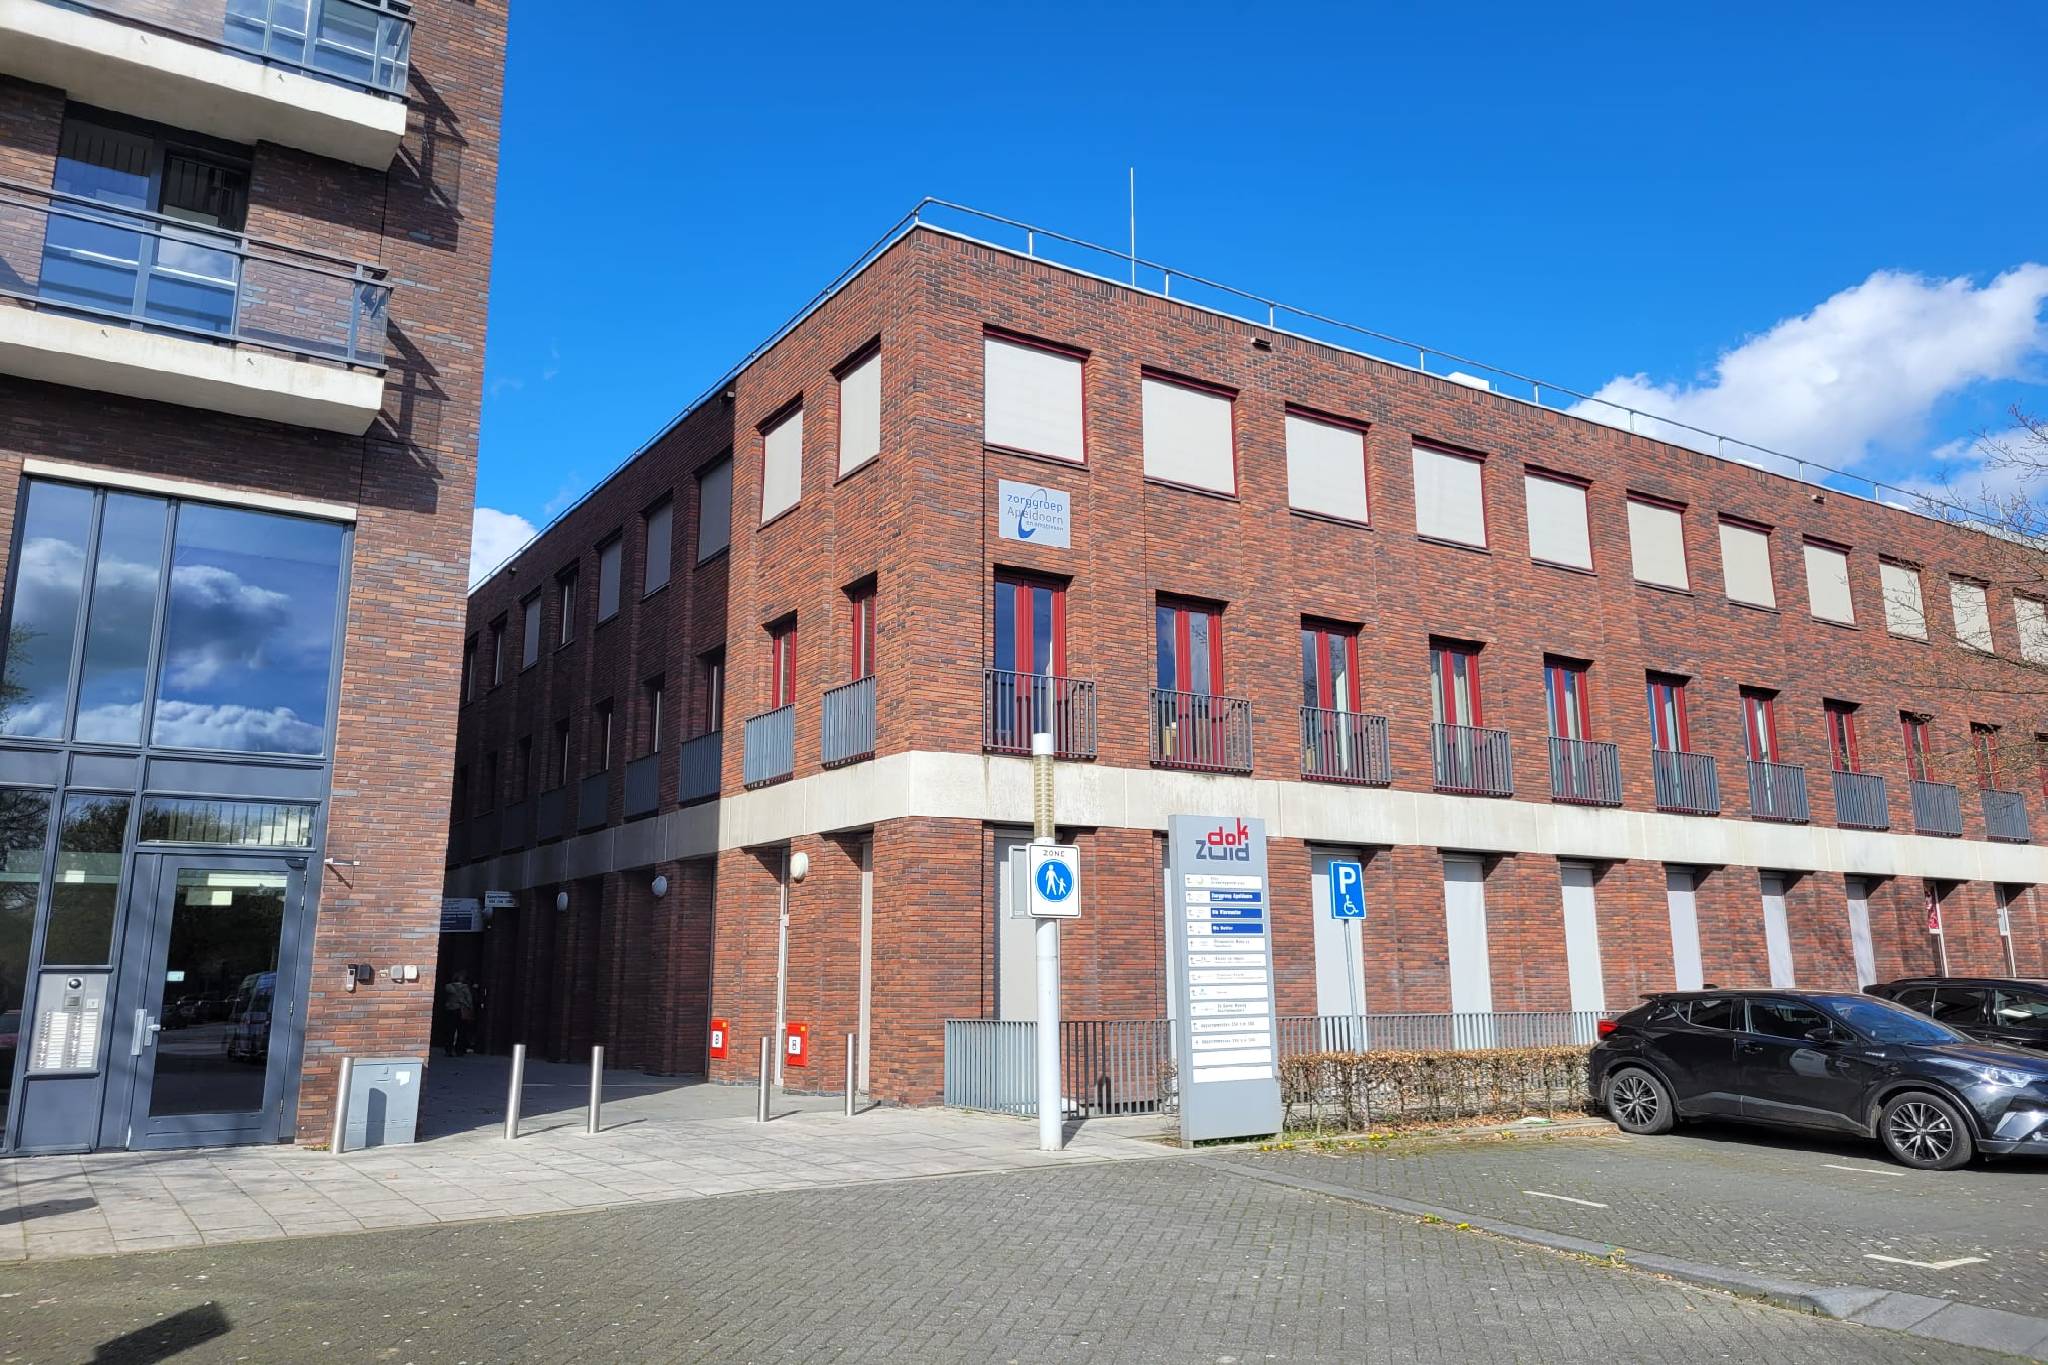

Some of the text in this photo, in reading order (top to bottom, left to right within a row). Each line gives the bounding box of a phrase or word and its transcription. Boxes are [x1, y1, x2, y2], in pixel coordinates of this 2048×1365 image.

[1008, 495, 1063, 512] zorggroep
[1008, 507, 1063, 524] Apeldoorn
[1207, 817, 1249, 846] dok
[1042, 849, 1065, 857] ZONE
[1339, 867, 1356, 894] P
